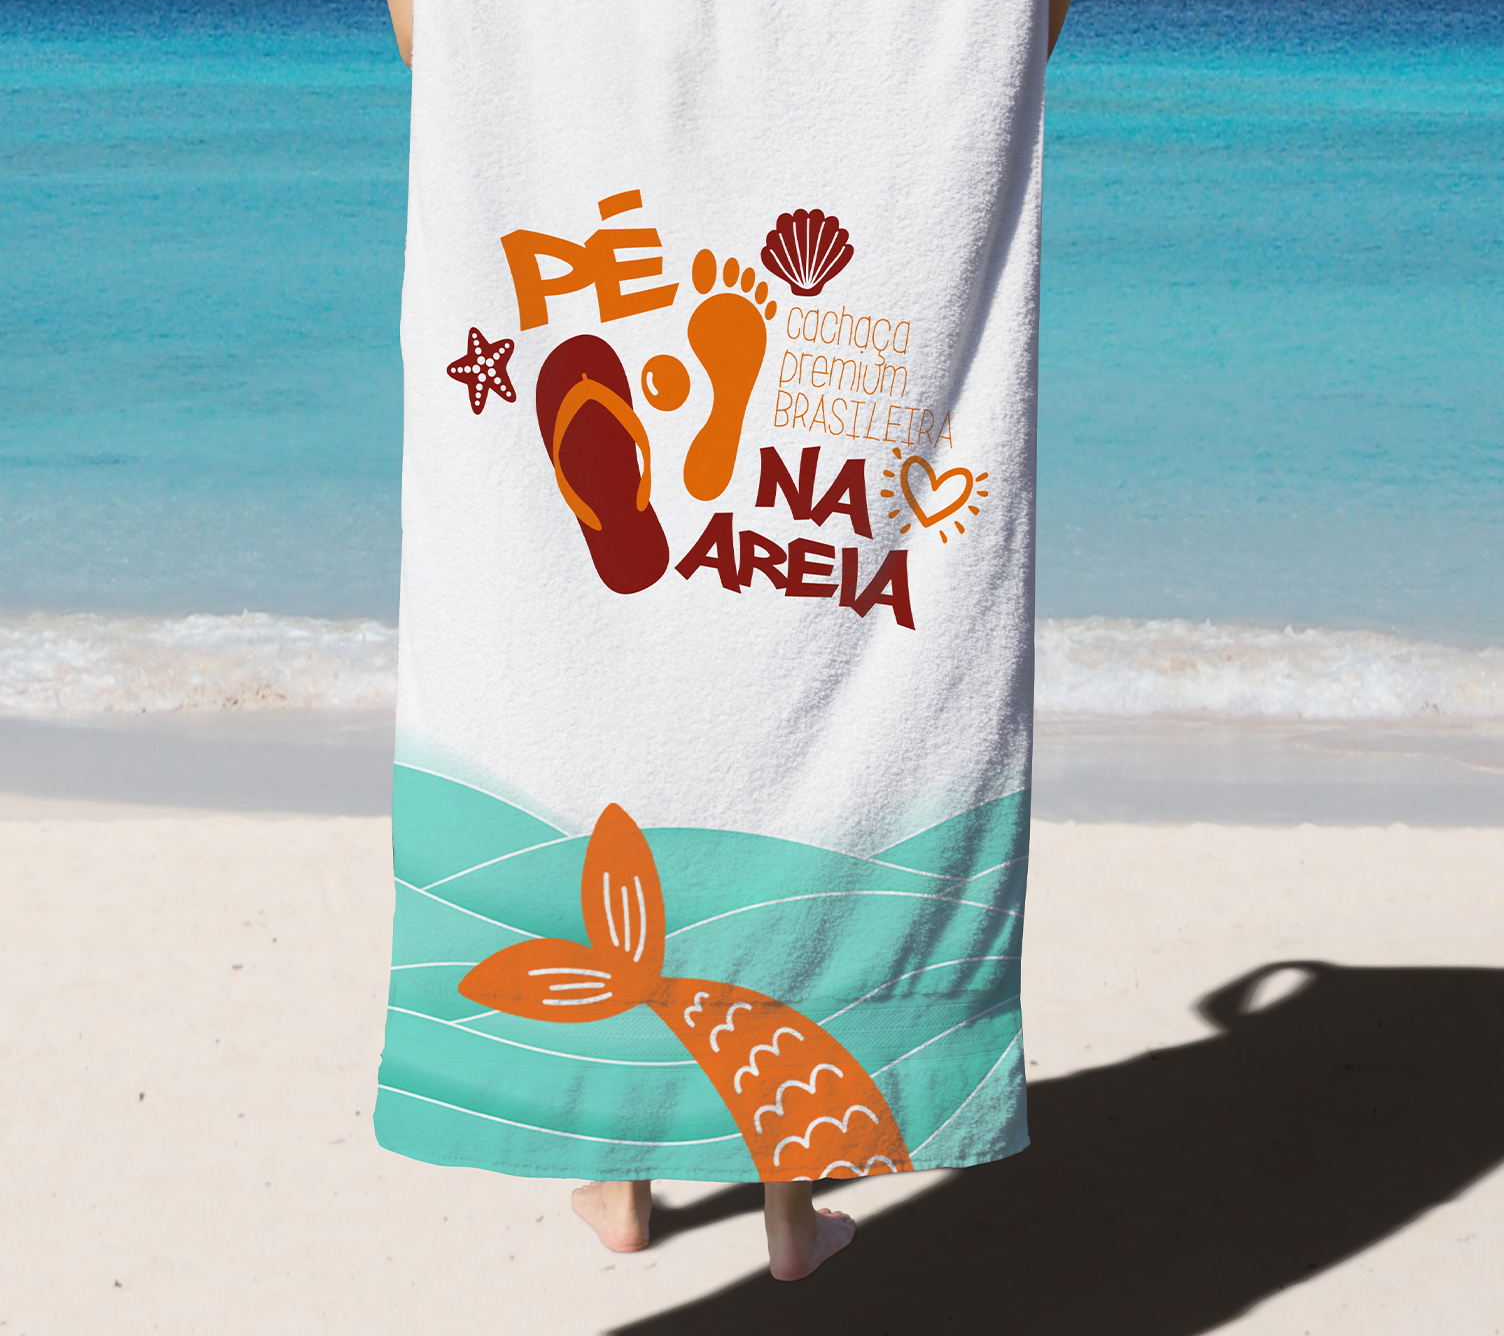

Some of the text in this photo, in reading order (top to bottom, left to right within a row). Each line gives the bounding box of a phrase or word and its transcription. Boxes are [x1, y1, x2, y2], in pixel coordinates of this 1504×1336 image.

[500, 189, 680, 332] PÉ
[778, 348, 908, 398] premium
[786, 305, 911, 366] cachaça
[773, 389, 953, 449] BRASILEIRA
[755, 446, 874, 540] NA
[674, 512, 916, 631] AREIA
